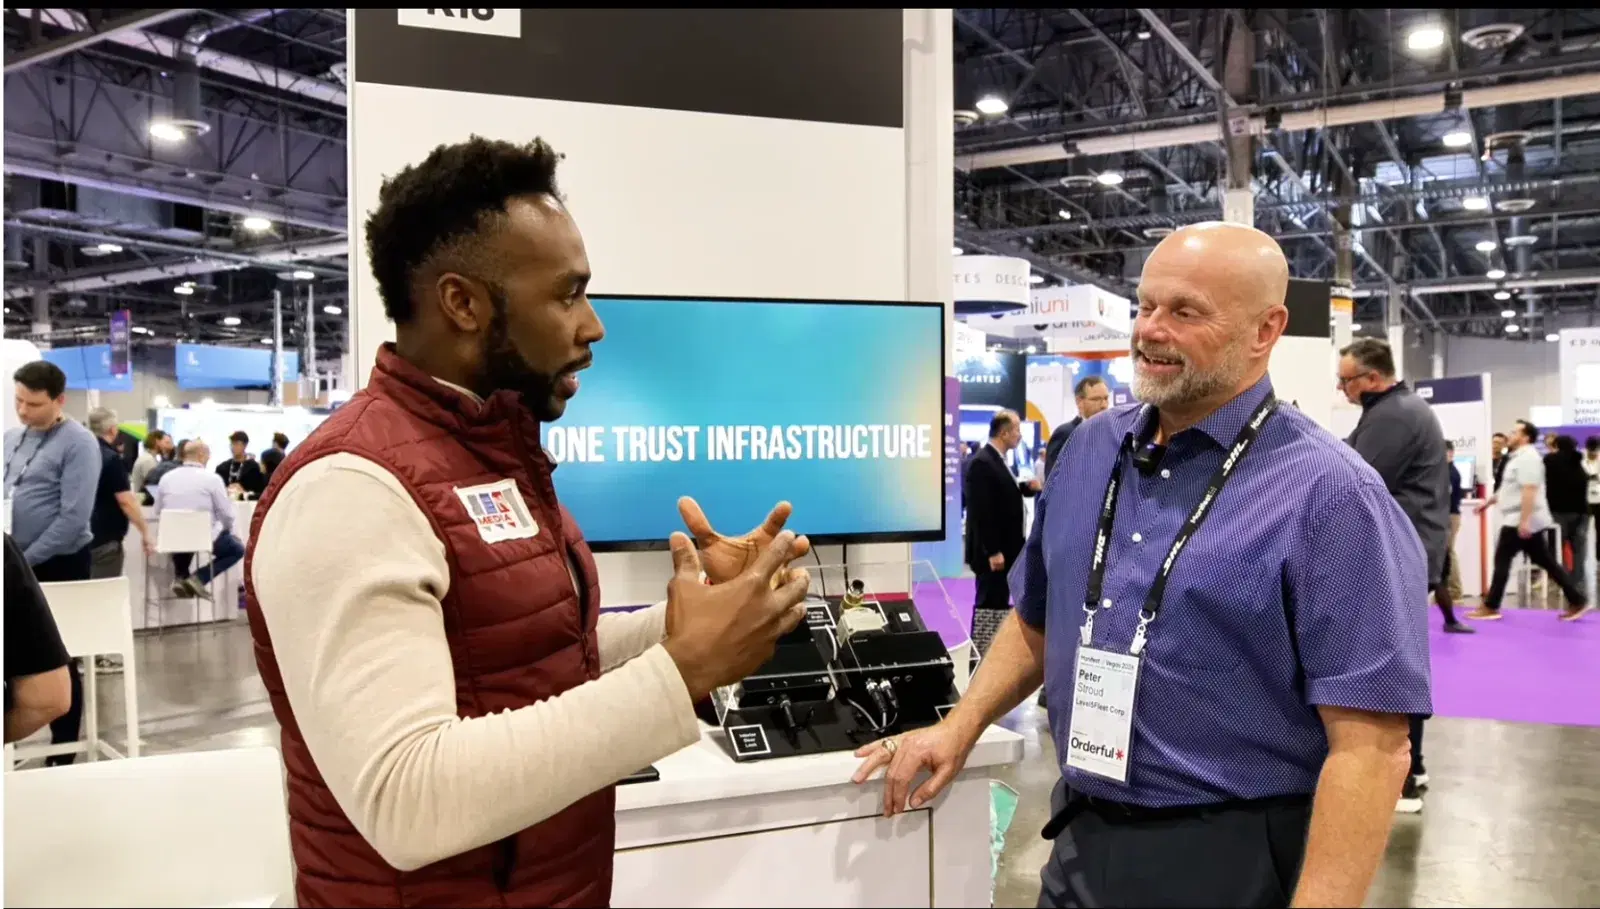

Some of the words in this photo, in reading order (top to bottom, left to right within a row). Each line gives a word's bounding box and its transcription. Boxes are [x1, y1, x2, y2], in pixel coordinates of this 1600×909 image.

[547, 425, 605, 463] ONE
[611, 425, 700, 462] TRUST
[707, 423, 932, 461] INFRASTRUCTURE
[1222, 438, 1249, 476] DHL
[478, 514, 512, 525] MEDIA
[1079, 669, 1102, 683] Peter
[1077, 682, 1104, 697] Stroud
[1109, 705, 1125, 717] Corp
[1071, 737, 1115, 759] Orderful
